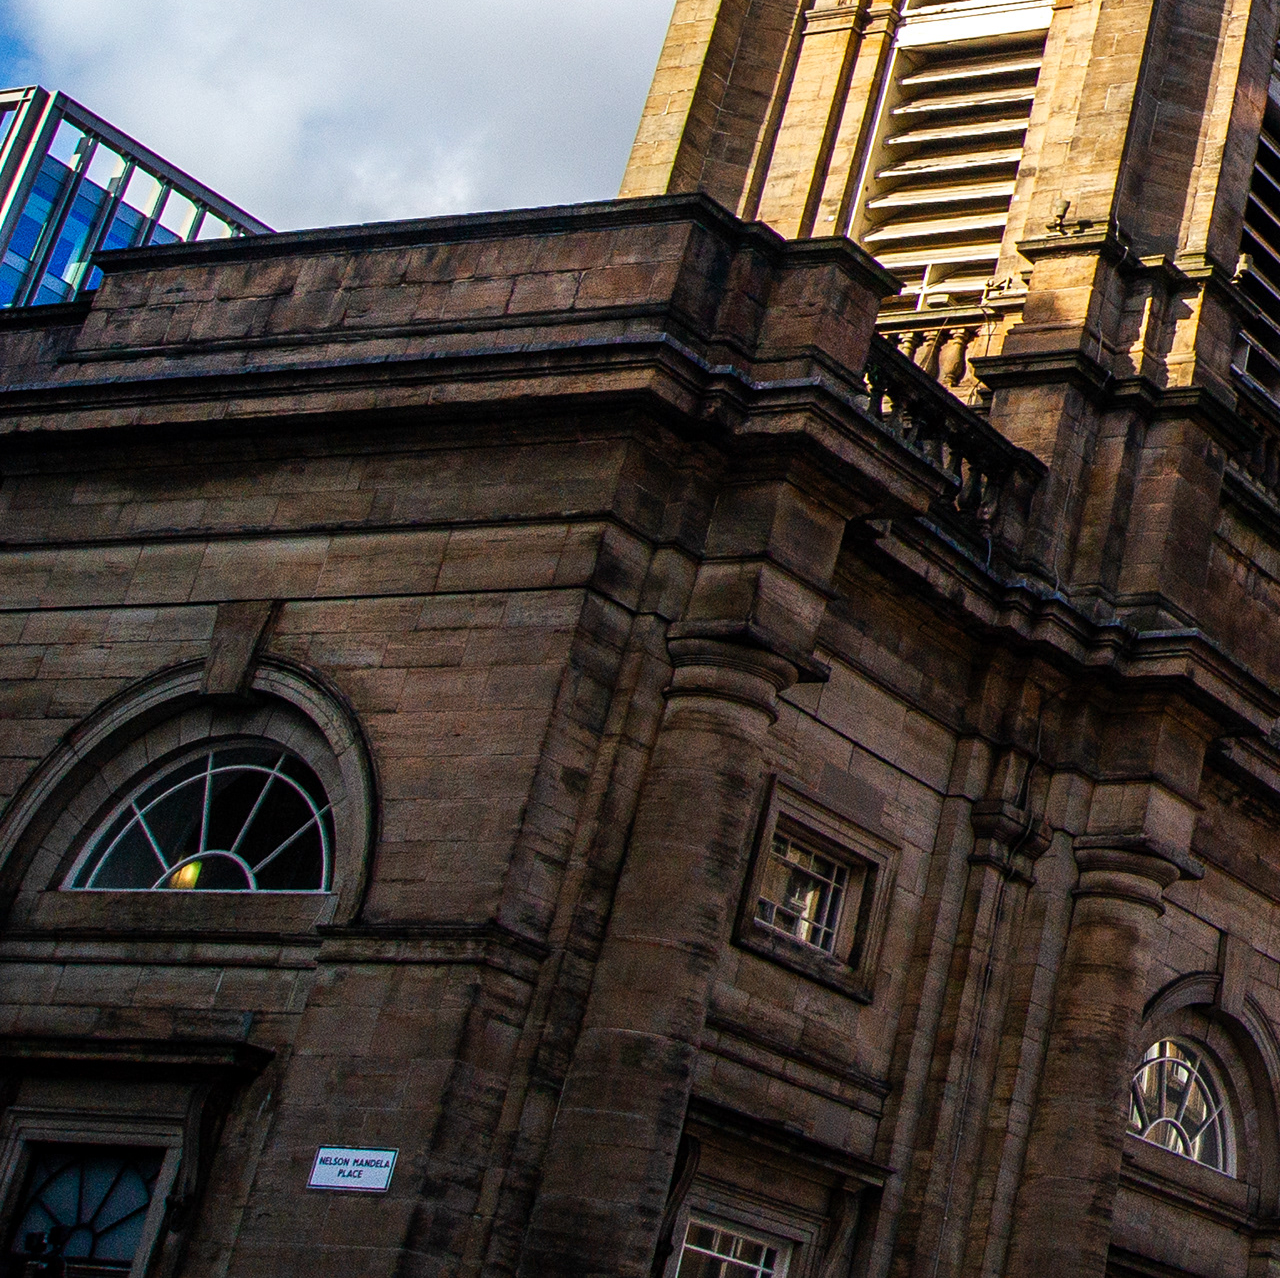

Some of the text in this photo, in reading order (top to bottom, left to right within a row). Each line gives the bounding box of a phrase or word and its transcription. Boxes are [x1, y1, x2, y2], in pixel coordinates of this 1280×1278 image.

[319, 1156, 390, 1168] NELSON MANDELA
[337, 1169, 364, 1179] PLACE
